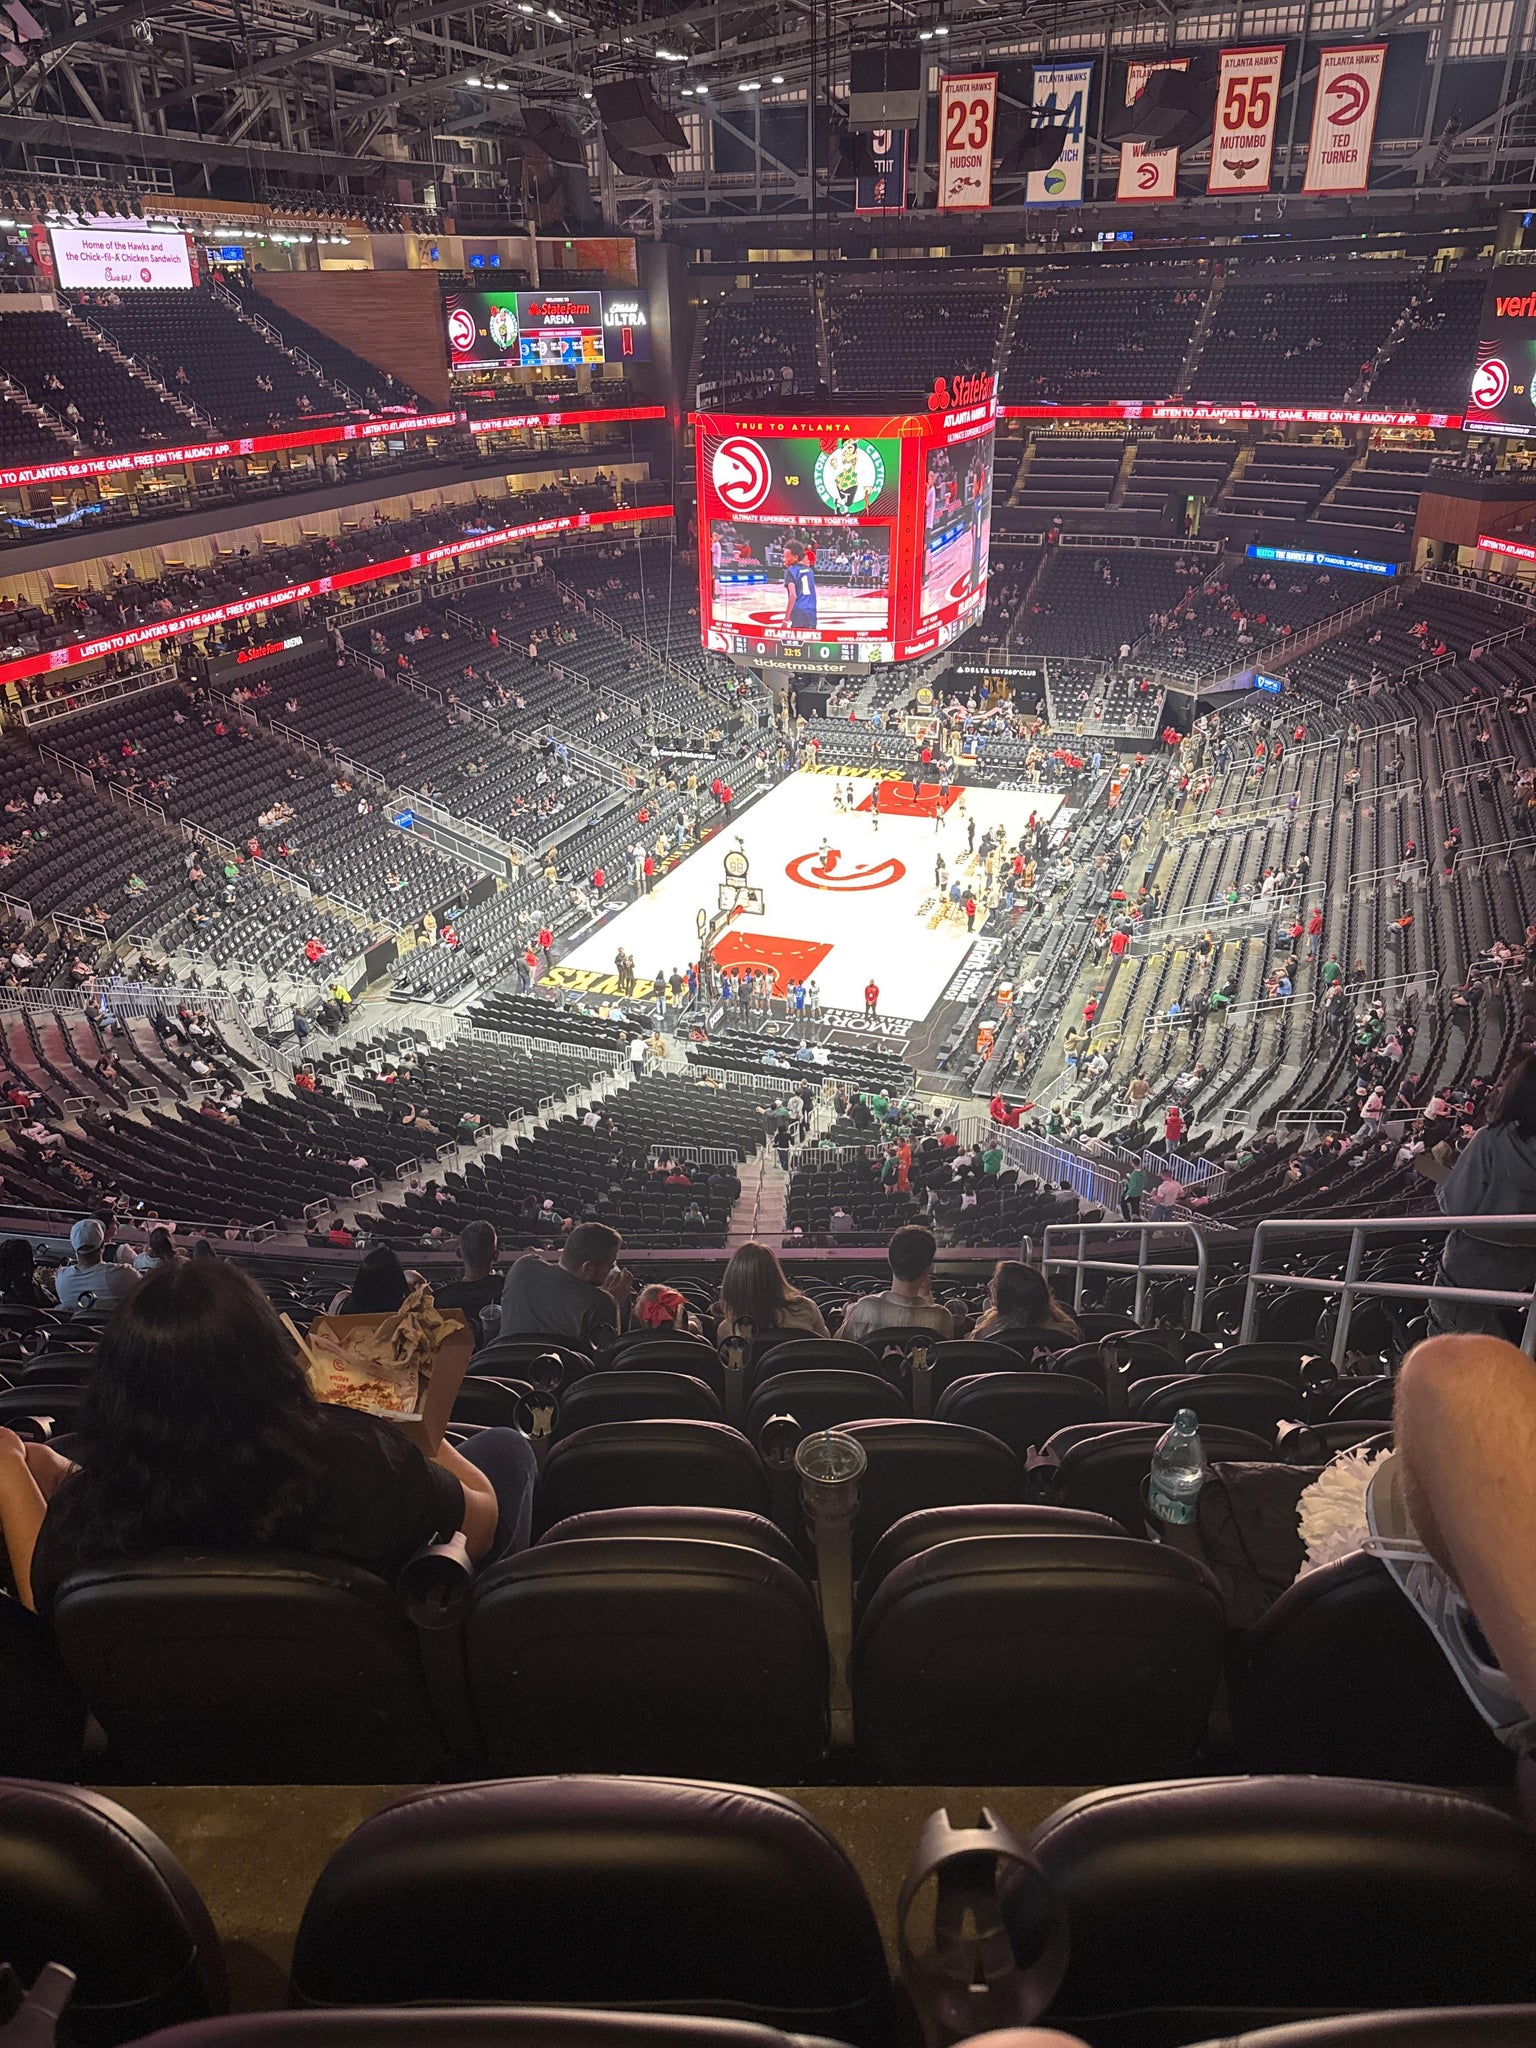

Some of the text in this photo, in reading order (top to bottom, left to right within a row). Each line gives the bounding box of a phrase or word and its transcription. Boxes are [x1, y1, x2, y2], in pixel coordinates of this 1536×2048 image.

[1224, 55, 1278, 68] ATLANTA HAWKS
[1324, 54, 1380, 67] ATLANTA HAWKS
[1038, 72, 1087, 83] ATLANTA HAWKS
[1131, 69, 1151, 79] ATLA
[944, 82, 992, 93] ATLANTA HAWKS
[1223, 75, 1272, 130] 55
[946, 99, 989, 151] 23
[1220, 134, 1266, 149] MUTOMBO
[1332, 133, 1350, 148] TED
[950, 155, 982, 169] HUDSON
[1321, 149, 1358, 164] TURNER
[82, 240, 163, 251] Home of the Hawks and
[65, 251, 181, 263] the Chick-fil-A Chicken Sandwich
[544, 314, 574, 324] ARENA
[604, 313, 646, 327] ULTRA
[502, 417, 526, 428] AUDACY
[943, 412, 970, 428] ATLANTA
[1152, 408, 1181, 417] LISTEN
[1182, 409, 1194, 417] TO
[1195, 409, 1241, 419] ATLANTA'S
[1260, 410, 1277, 419] THE
[1306, 412, 1329, 421] FREE
[1329, 413, 1343, 422] ON
[1343, 413, 1360, 422] THE
[1361, 414, 1396, 424] AUDACY
[1397, 415, 1417, 424] APP.
[735, 422, 851, 432] TRUE TO ATLANTA
[4, 444, 232, 484] TO ATLANTA'S 92.9 THE GAME, FREE ON THE AUDACY APP.
[866, 445, 882, 494] CELTICS
[785, 476, 800, 486] VS
[732, 514, 759, 523] ULTIMATE
[1480, 538, 1499, 550] LISTEN
[1498, 543, 1506, 551] TO
[1275, 550, 1286, 559] THE
[1286, 551, 1305, 561] HAWKS
[1306, 553, 1314, 562] ON
[1364, 563, 1387, 573] NETWORK
[80, 640, 111, 657] LISTEN
[111, 637, 124, 648] TO
[125, 625, 168, 645] ATLANTA'S
[185, 616, 201, 631] THE
[226, 604, 245, 619] FREE
[244, 602, 256, 613] ON
[254, 598, 270, 610] THE
[270, 591, 297, 606] AUDACY
[297, 586, 313, 600] APP.
[764, 628, 822, 641] ATLANTA HAWKS
[283, 636, 303, 650] ARENA
[757, 642, 766, 654] 0
[783, 647, 802, 657] 33:15
[820, 647, 830, 659] 0
[753, 658, 846, 673] ticketmaster
[659, 749, 717, 760] Georgia Natural Gas
[996, 780, 1066, 791] EMORY
[814, 1013, 912, 1037] EMORY
